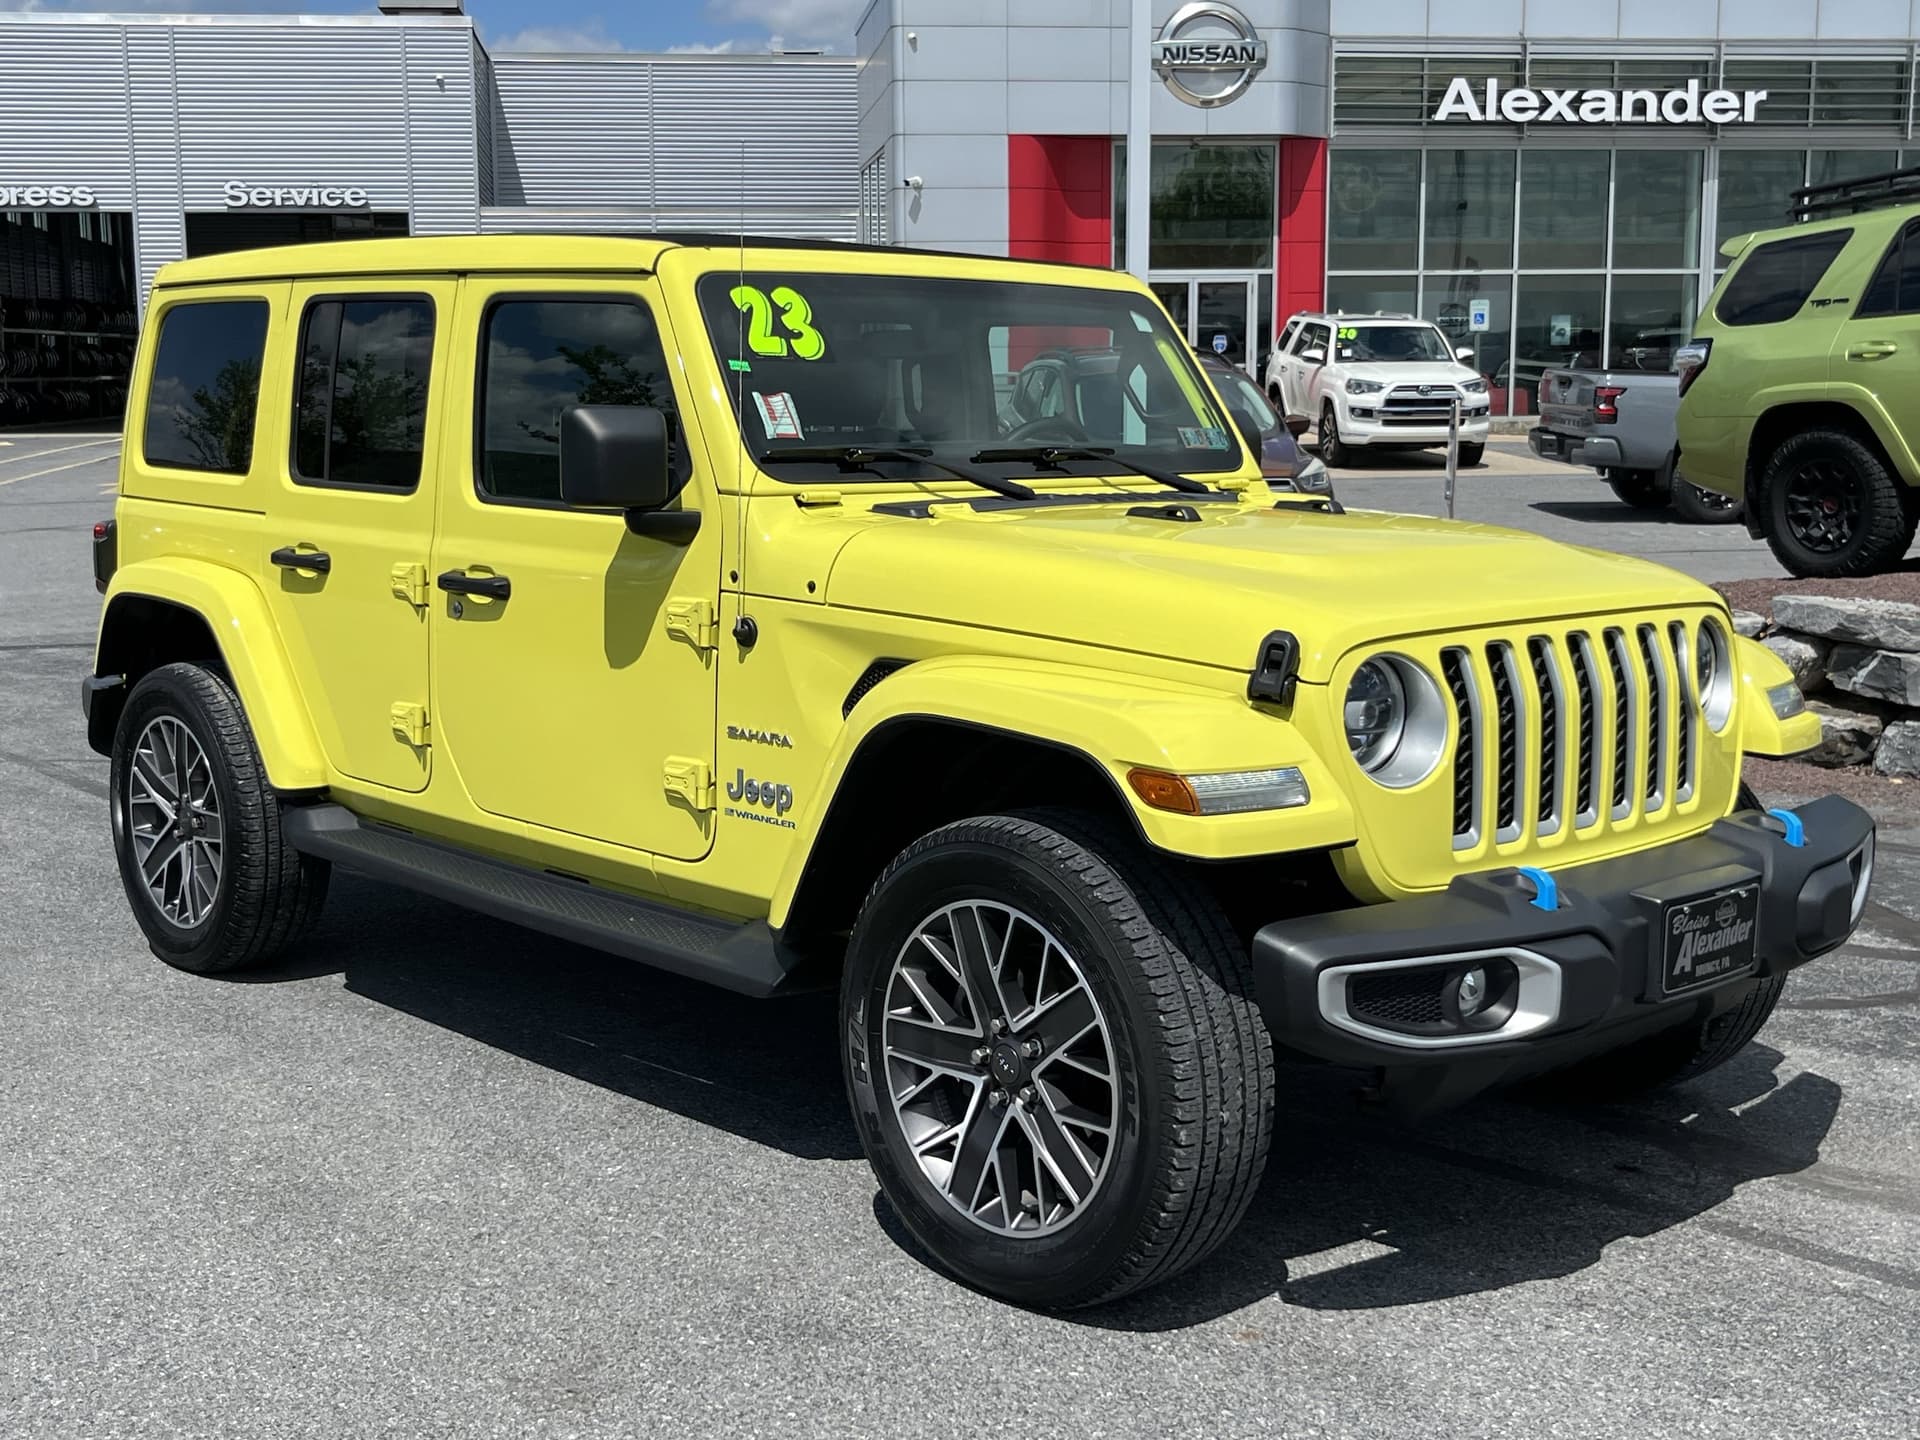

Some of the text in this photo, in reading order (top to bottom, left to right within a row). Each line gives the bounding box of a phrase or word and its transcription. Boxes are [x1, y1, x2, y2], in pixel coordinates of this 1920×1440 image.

[1162, 45, 1256, 64] NISSAN
[1433, 77, 1767, 123] Alexander
[223, 180, 368, 207] Service
[729, 285, 825, 360] 23
[1337, 328, 1358, 340] 20
[727, 725, 793, 749] SAHARA
[726, 768, 793, 817] Jeep
[735, 809, 797, 830] WRANGLER
[1672, 913, 1710, 935] Blaise
[1672, 918, 1753, 976] Alexander
